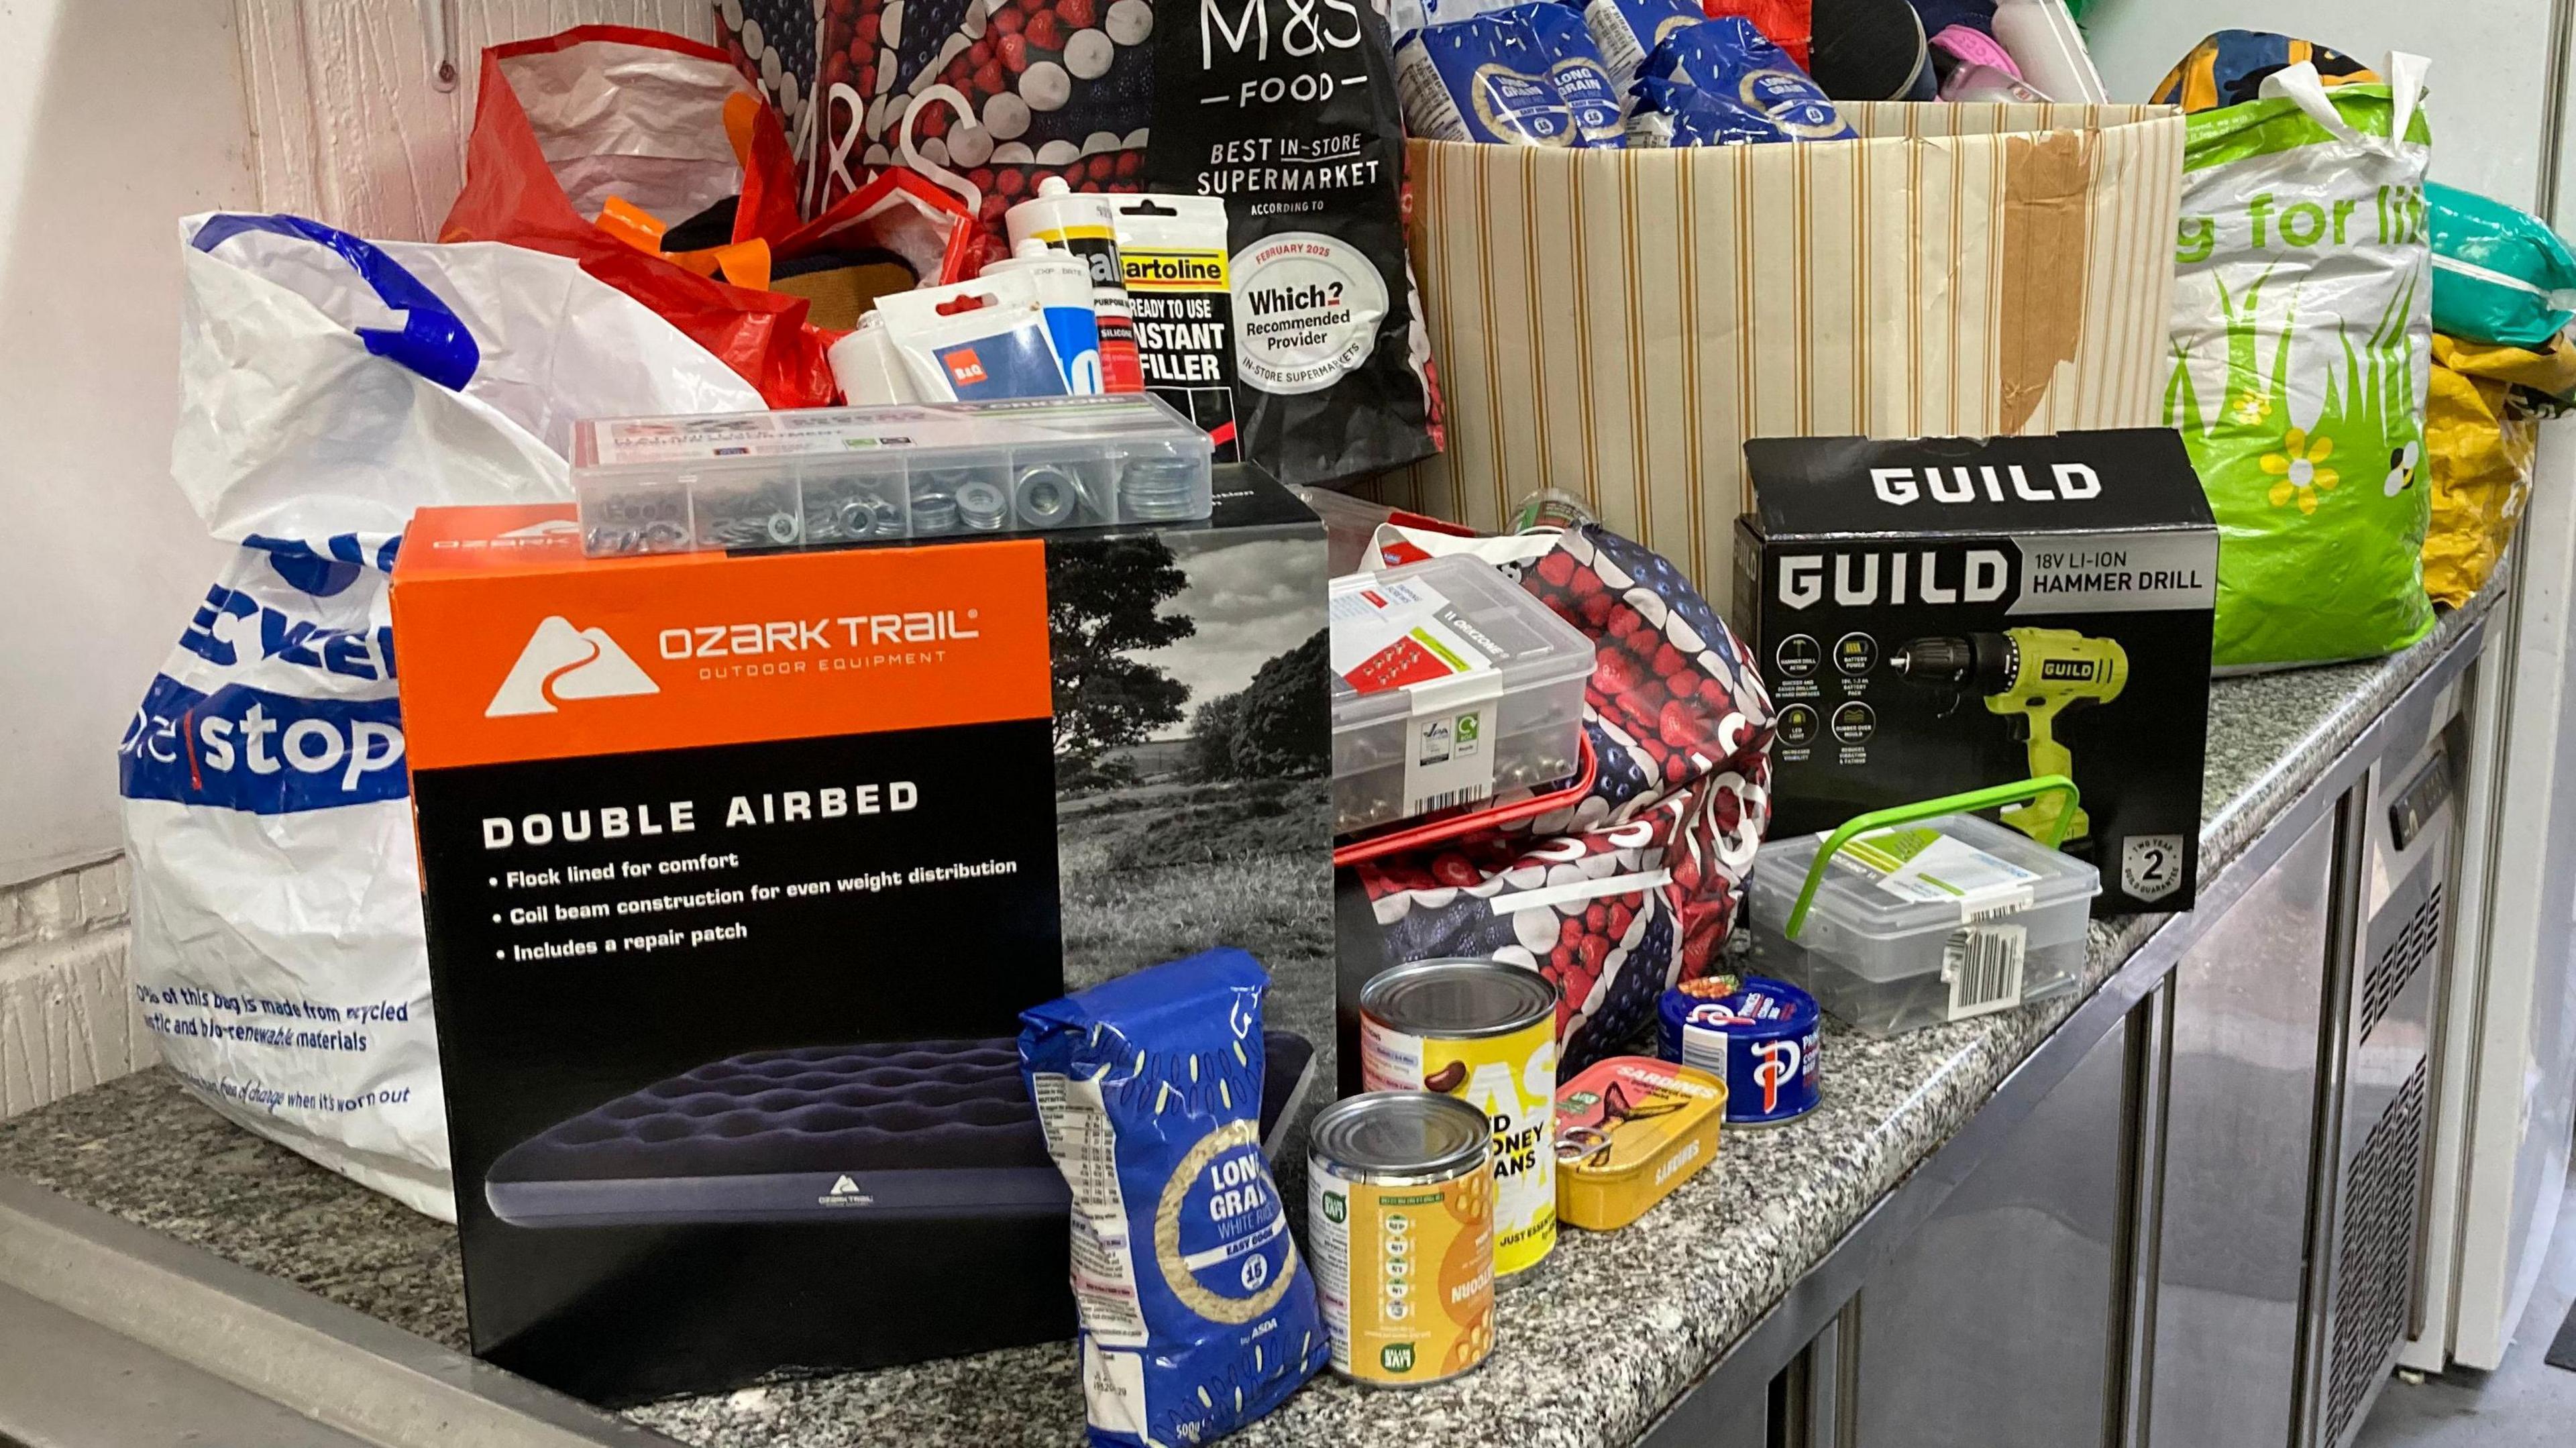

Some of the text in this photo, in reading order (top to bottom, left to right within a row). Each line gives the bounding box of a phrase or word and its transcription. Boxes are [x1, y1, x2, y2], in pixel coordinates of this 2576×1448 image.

[1201, 0, 1362, 69] M&S
[1240, 73, 1334, 107] FOOD
[1554, 68, 1593, 87] LONG
[1558, 79, 1602, 96] GRAIN
[1211, 133, 1360, 165] BEST IN-STORE
[1197, 160, 1379, 195] SUPERMARKET
[1251, 201, 1324, 215] ACCORDING TO
[2249, 193, 2355, 248] for
[1256, 244, 1303, 265] FEBRUARY
[1130, 299, 1212, 319] READY TO USE
[1248, 281, 1343, 316] Which?
[1133, 323, 1225, 349] NSTANT
[1246, 309, 1350, 336] Recommended
[1268, 331, 1328, 351] Provider
[954, 365, 983, 380] B&Q
[1140, 354, 1220, 381] FILLER
[1243, 341, 1360, 383] IN-STORE SUPERMARKETS
[1869, 463, 2102, 506] GUILD
[2035, 551, 2127, 569] 18V LI-ION
[1778, 550, 2008, 610] GUILD
[2033, 569, 2202, 594] HAMMER DRILL
[659, 618, 831, 660] OZARK
[699, 651, 946, 680] OUTDOOR EQUIPMENT
[2044, 662, 2092, 678] GUILD
[201, 703, 405, 791] stop
[482, 781, 918, 849] DOUBLE AIRBED
[506, 853, 739, 889] Flock lined for comfort
[2142, 849, 2163, 880] 2
[510, 859, 1018, 925] Coil beam construction for even weight distribution
[514, 922, 748, 962] Includes a repair patch
[162, 987, 178, 1003] of
[180, 987, 209, 1006] this
[213, 991, 240, 1015] bag
[241, 995, 256, 1012] is
[259, 999, 301, 1017] made
[303, 1000, 340, 1022] from
[174, 1017, 197, 1037] and
[297, 1029, 367, 1051] materials
[288, 1091, 316, 1109] when
[319, 1091, 334, 1110] it's
[337, 1093, 376, 1112] worn
[379, 1087, 411, 1105] out
[1211, 1152, 1260, 1192] LON
[1218, 1214, 1254, 1239] WHITE
[1500, 1231, 1525, 1247] JUST
[1227, 1239, 1250, 1256] EASY
[1252, 1318, 1277, 1339] ASDA
[1176, 1421, 1200, 1438] 500g
